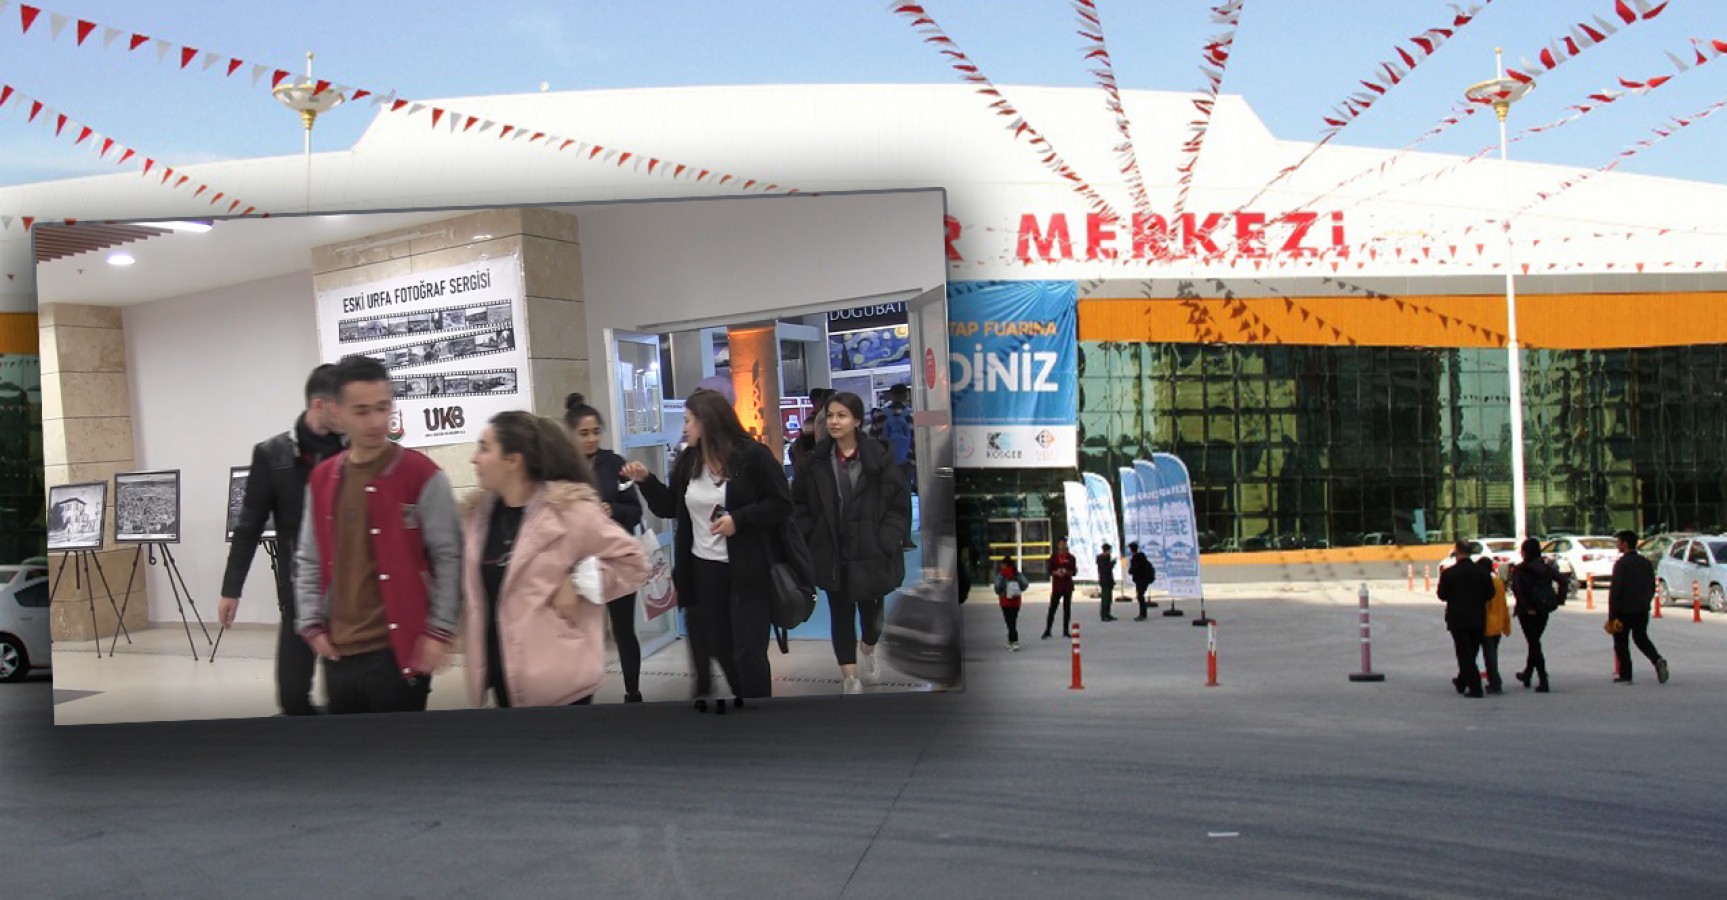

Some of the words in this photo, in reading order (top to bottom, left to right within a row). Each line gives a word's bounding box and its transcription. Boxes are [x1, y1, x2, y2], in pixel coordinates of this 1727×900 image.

[343, 292, 366, 313] ESKİ
[367, 290, 392, 309] URFA
[394, 280, 446, 304] FOTOĞRAF
[449, 268, 491, 294] SERGİSİ
[984, 320, 1058, 337] FUARINA
[423, 405, 465, 431] UKB
